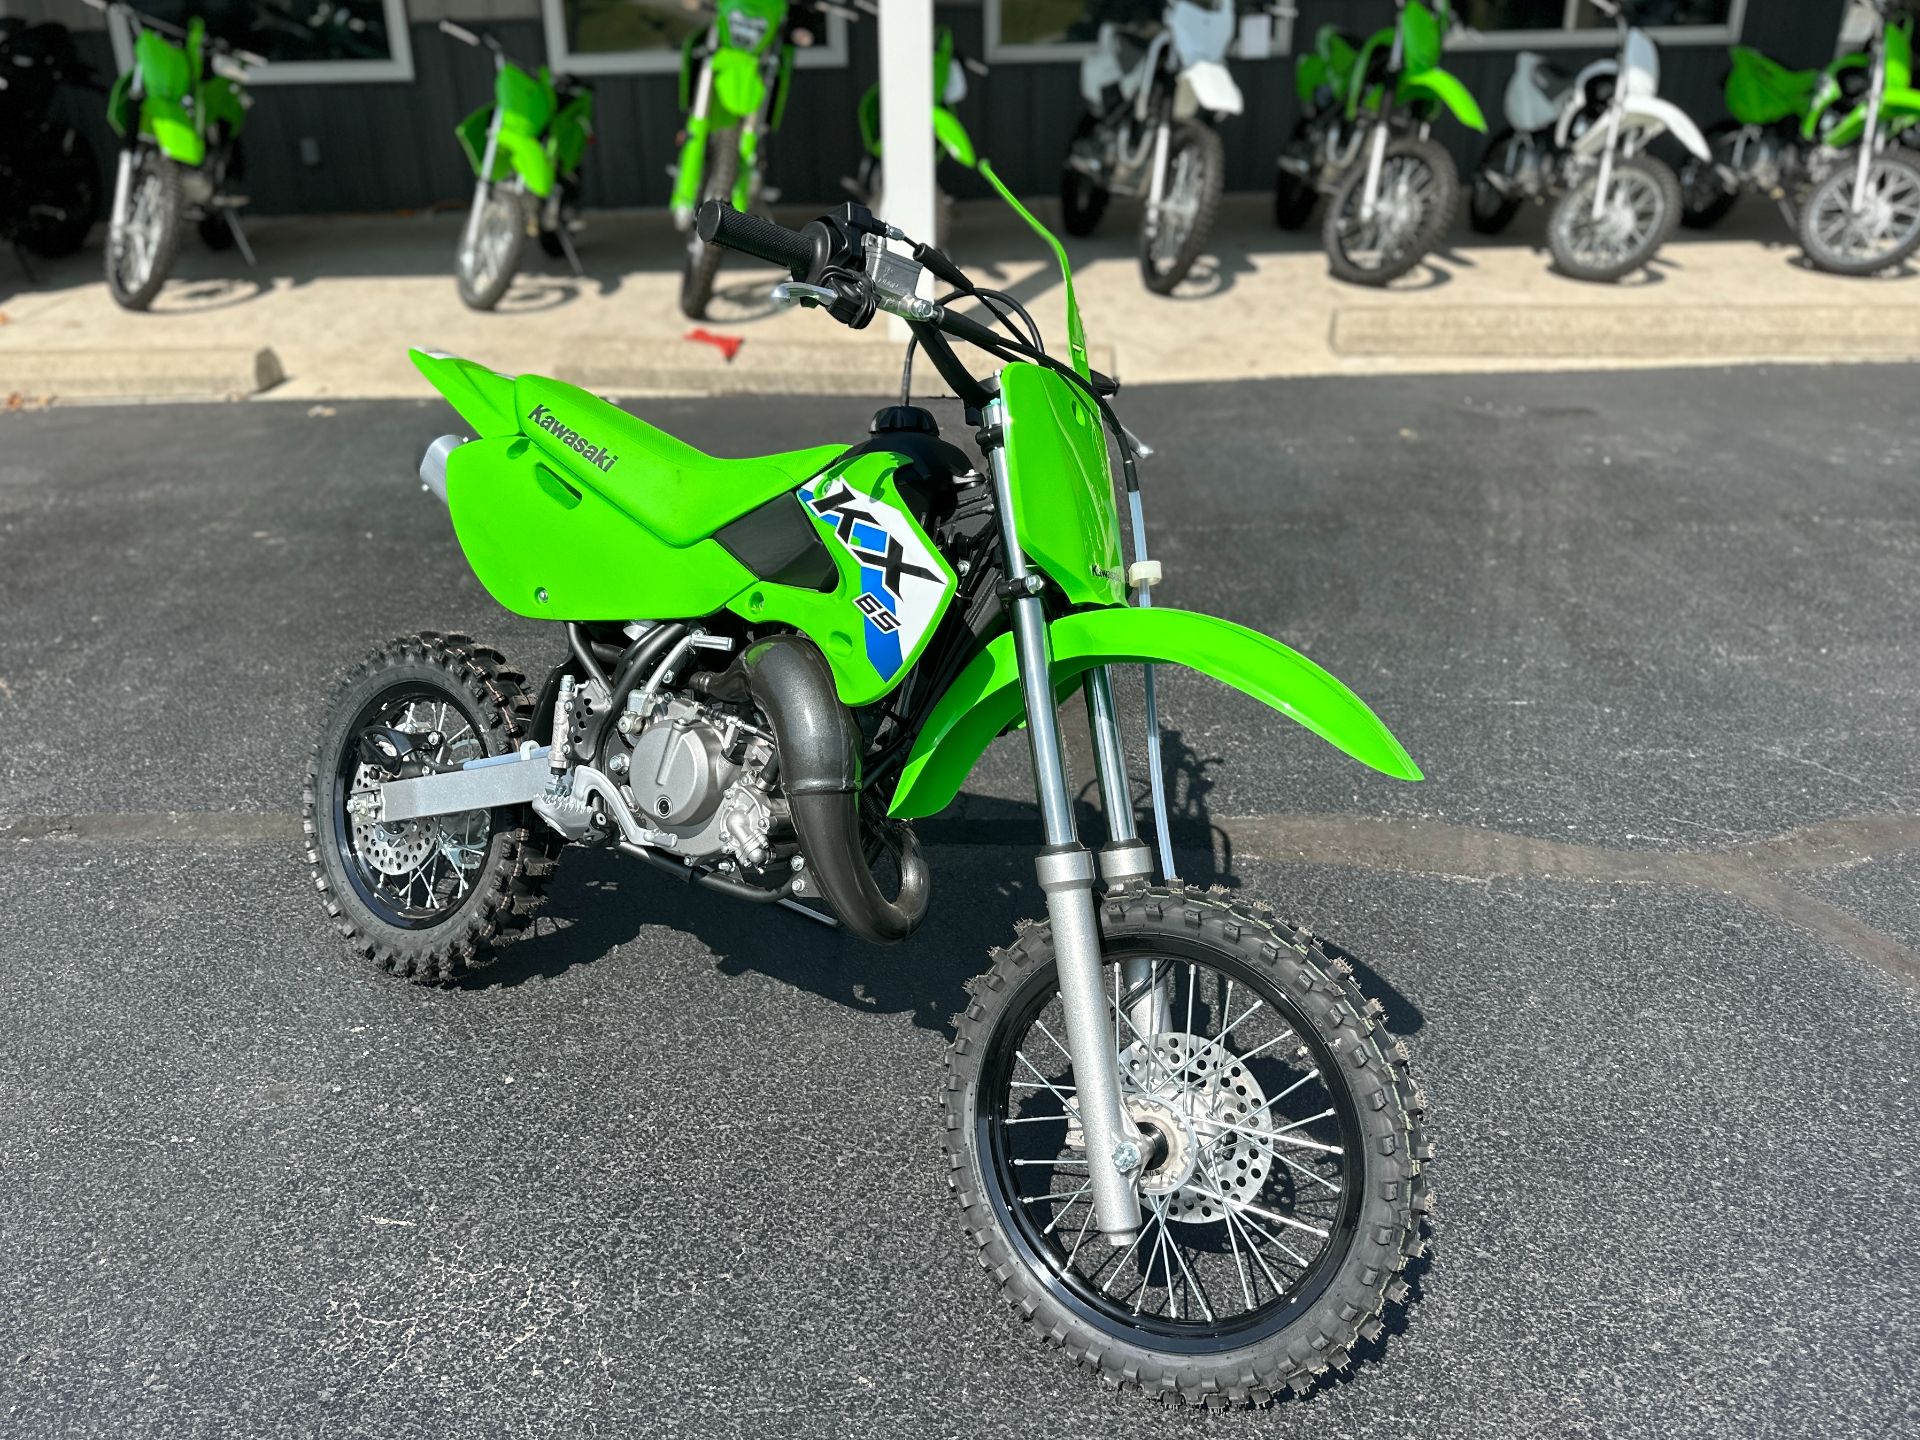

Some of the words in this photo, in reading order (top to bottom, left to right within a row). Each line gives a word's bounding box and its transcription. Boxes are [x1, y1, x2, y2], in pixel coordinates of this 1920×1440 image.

[527, 403, 619, 473] Kawasaki
[811, 483, 946, 602] KX
[857, 595, 902, 632] 65
